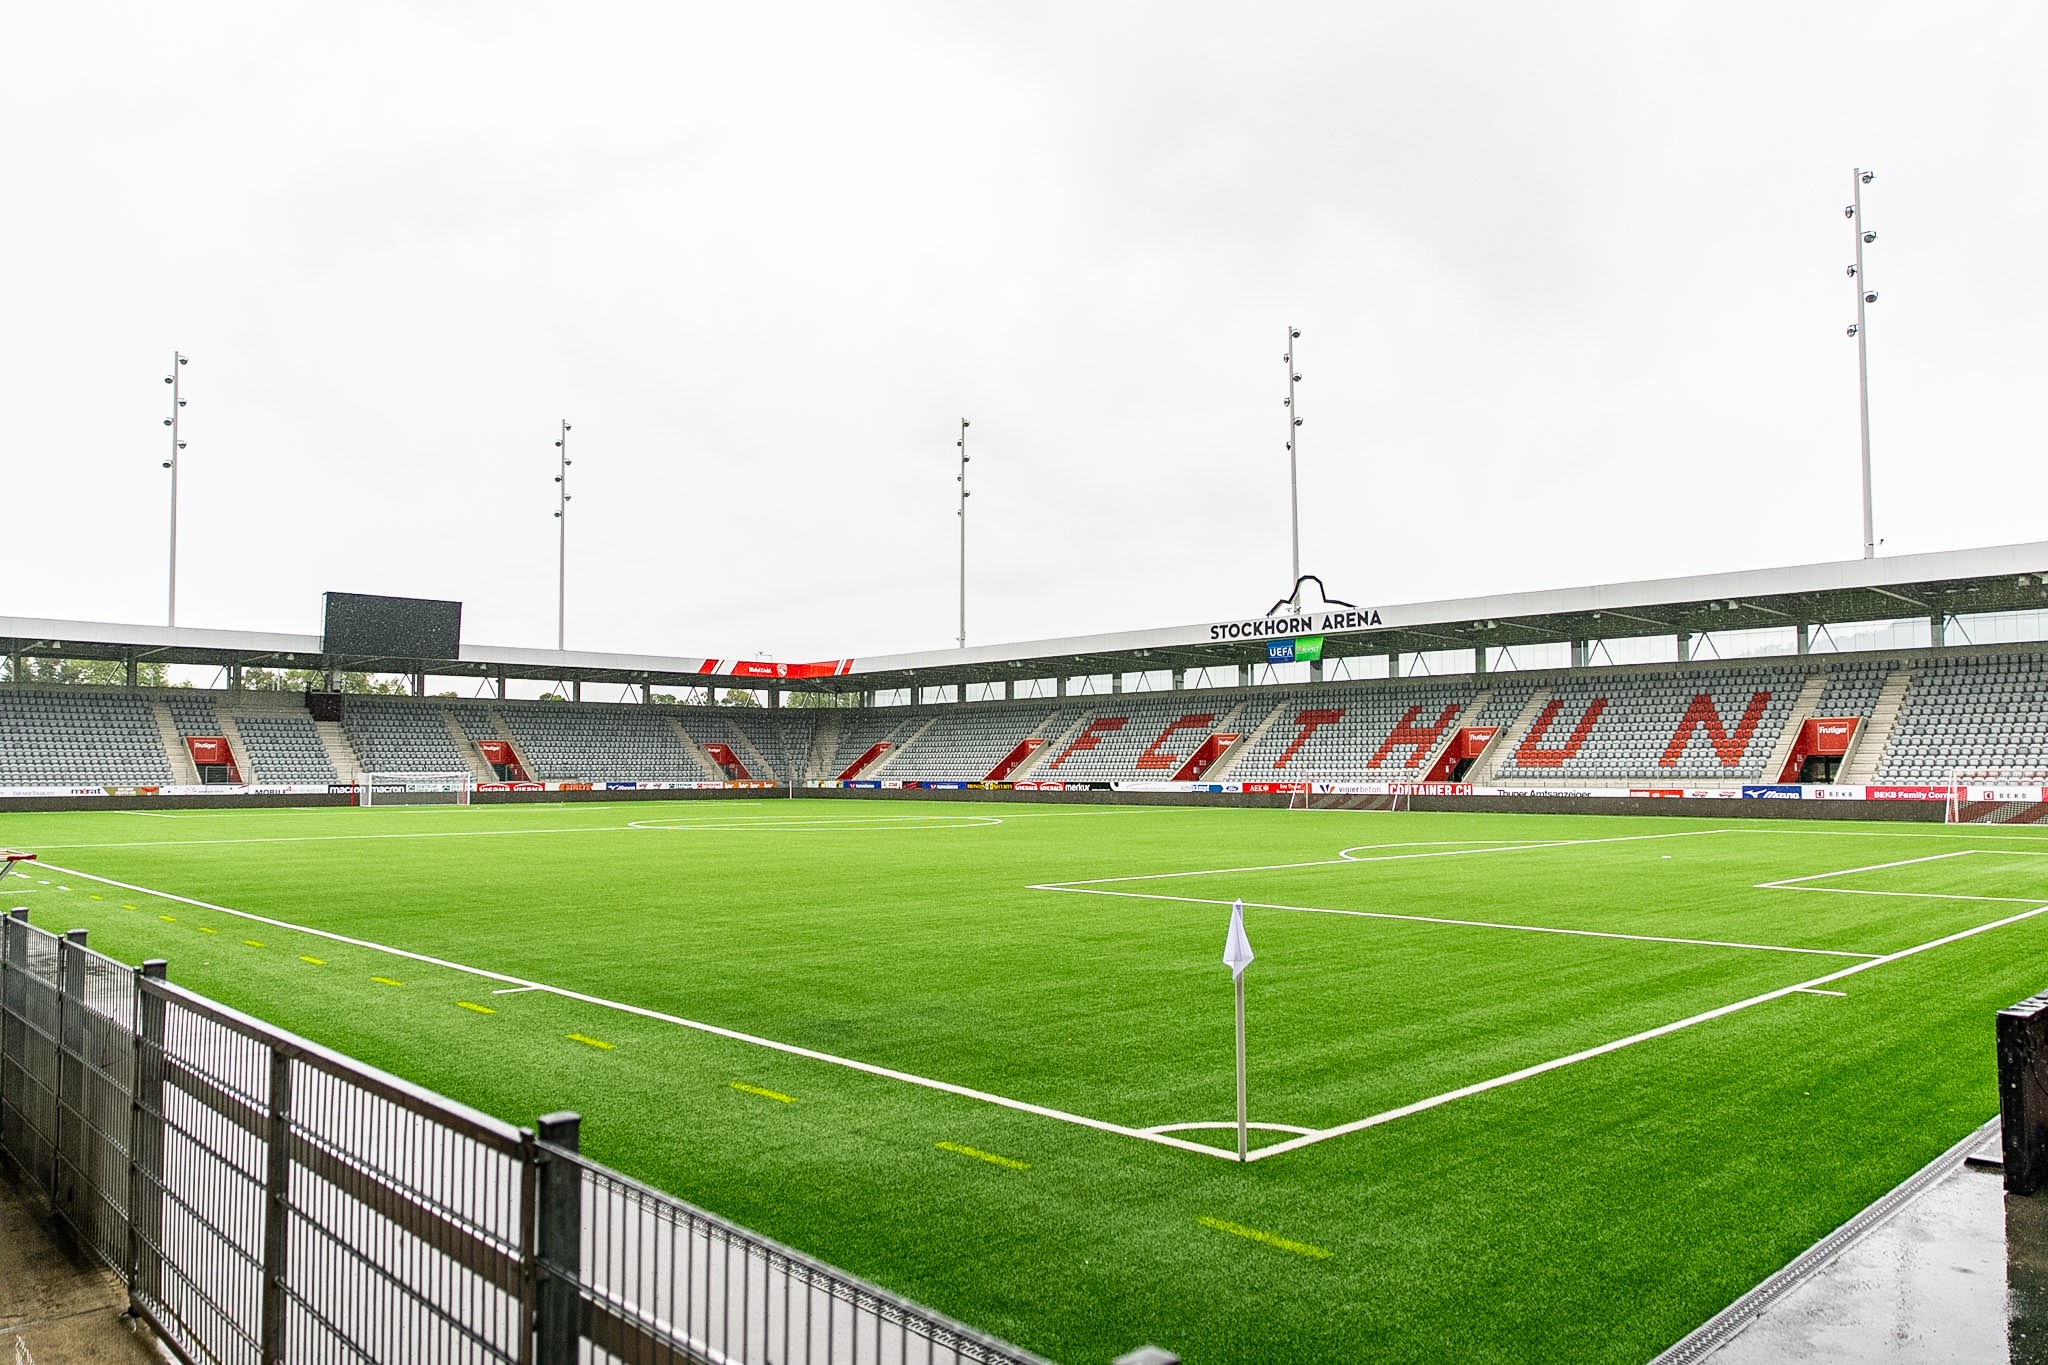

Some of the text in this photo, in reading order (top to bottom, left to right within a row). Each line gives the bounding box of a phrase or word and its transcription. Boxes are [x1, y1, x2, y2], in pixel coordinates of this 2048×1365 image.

[1210, 609, 1382, 640] STOCKHORN ARENA
[1269, 647, 1293, 657] UEFA
[1819, 726, 1847, 734] Frutiger
[371, 785, 405, 793] macron
[1065, 783, 1091, 792] merkur
[1250, 784, 1263, 792] AEK
[1389, 784, 1472, 796] CONTAINER.CH
[1873, 791, 1897, 799] BEKB
[1898, 791, 1928, 801] Family
